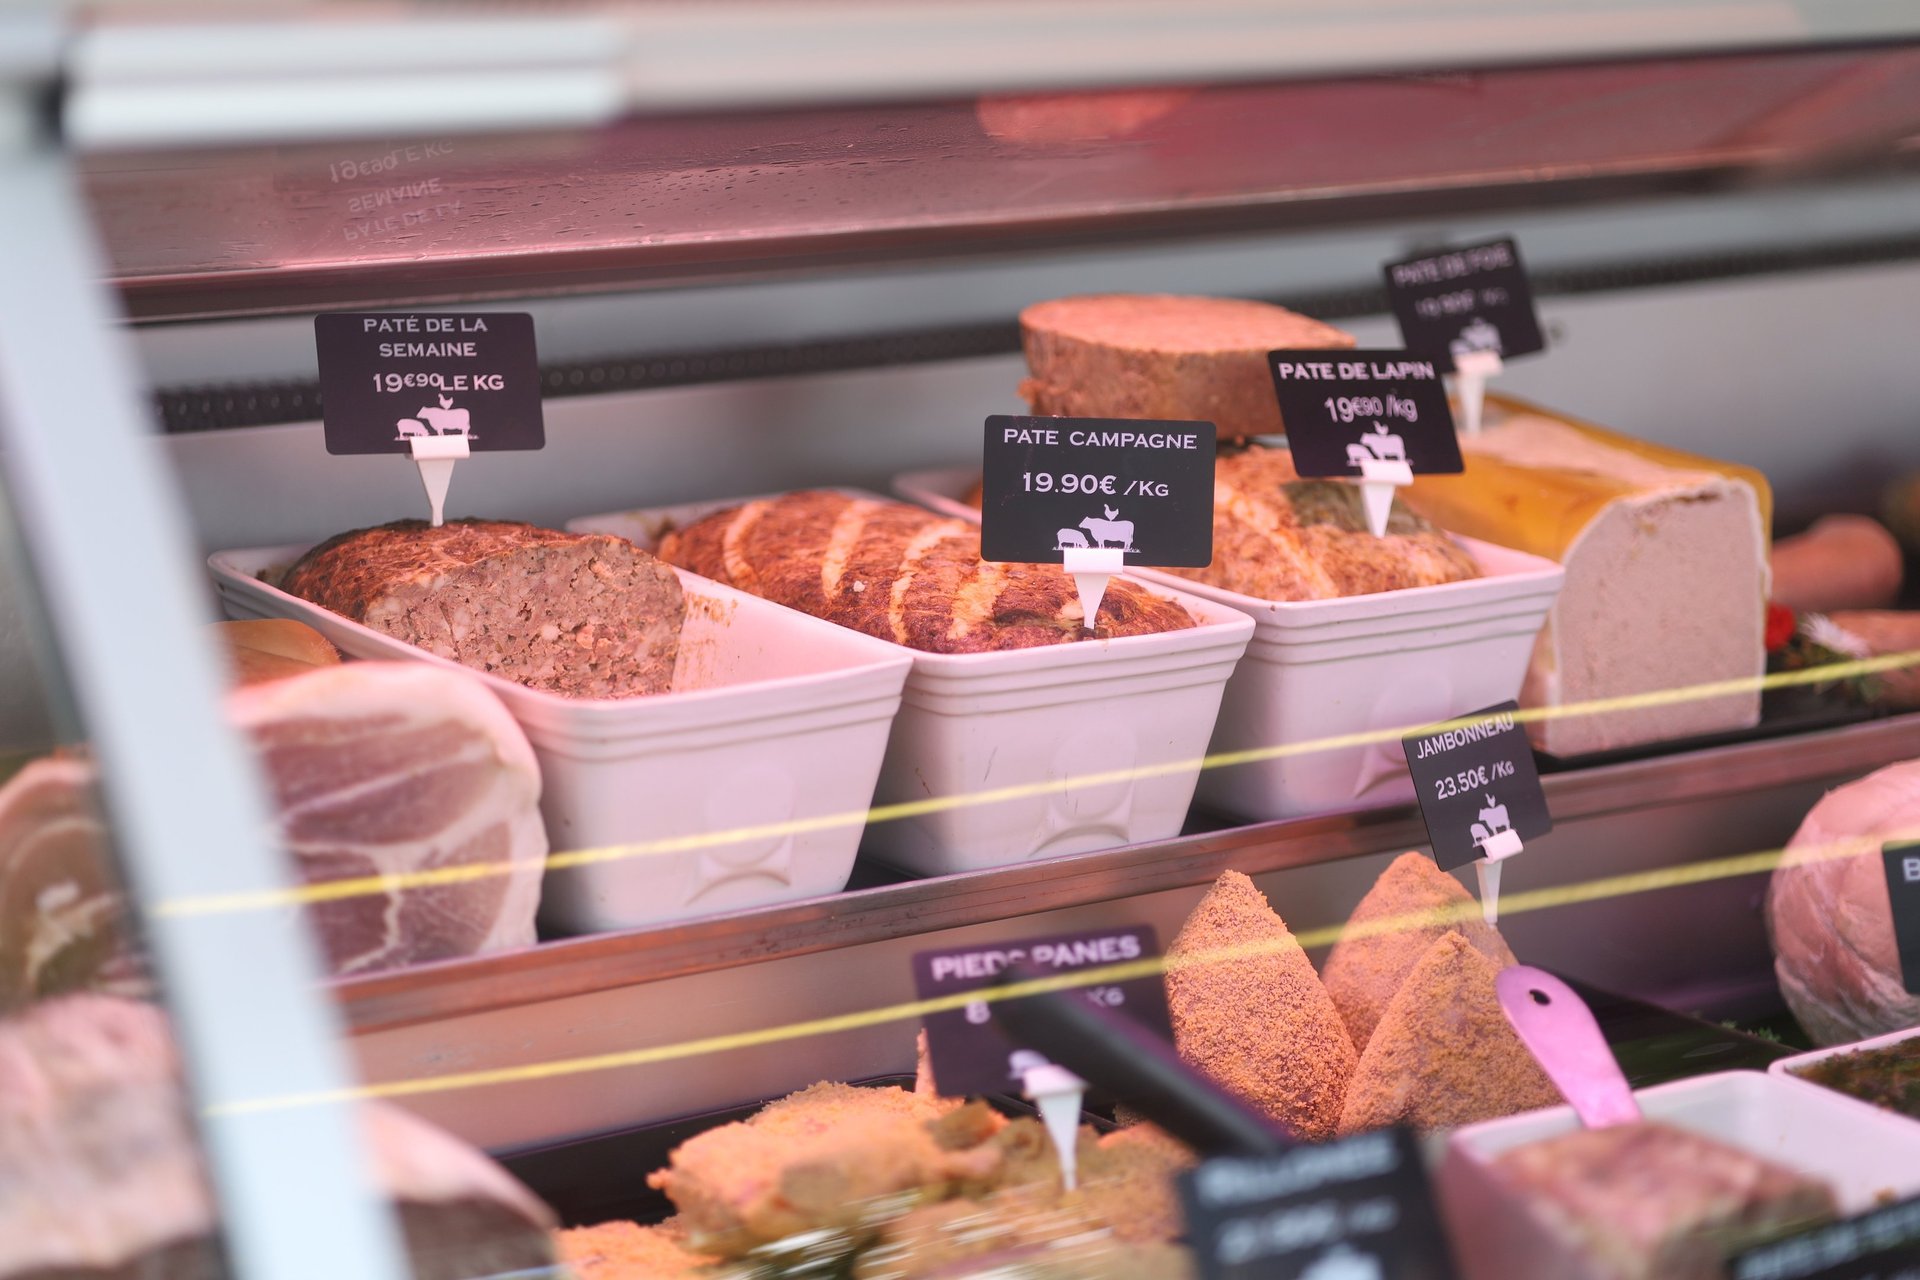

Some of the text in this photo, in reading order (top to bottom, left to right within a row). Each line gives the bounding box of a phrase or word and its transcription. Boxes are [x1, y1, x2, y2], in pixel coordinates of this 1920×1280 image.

[363, 315, 488, 333] PATÉ DE LA
[379, 342, 478, 358] SEMAINE
[1278, 361, 1435, 380] PATE DE LAPIN
[473, 374, 505, 391] KG
[1324, 396, 1384, 423] 19€90
[1004, 428, 1198, 450] PATE CAMPAGNE
[1023, 472, 1117, 495] 19.90€
[1417, 712, 1515, 760] JAMBONNEAU
[1435, 765, 1490, 801] 23.50€
